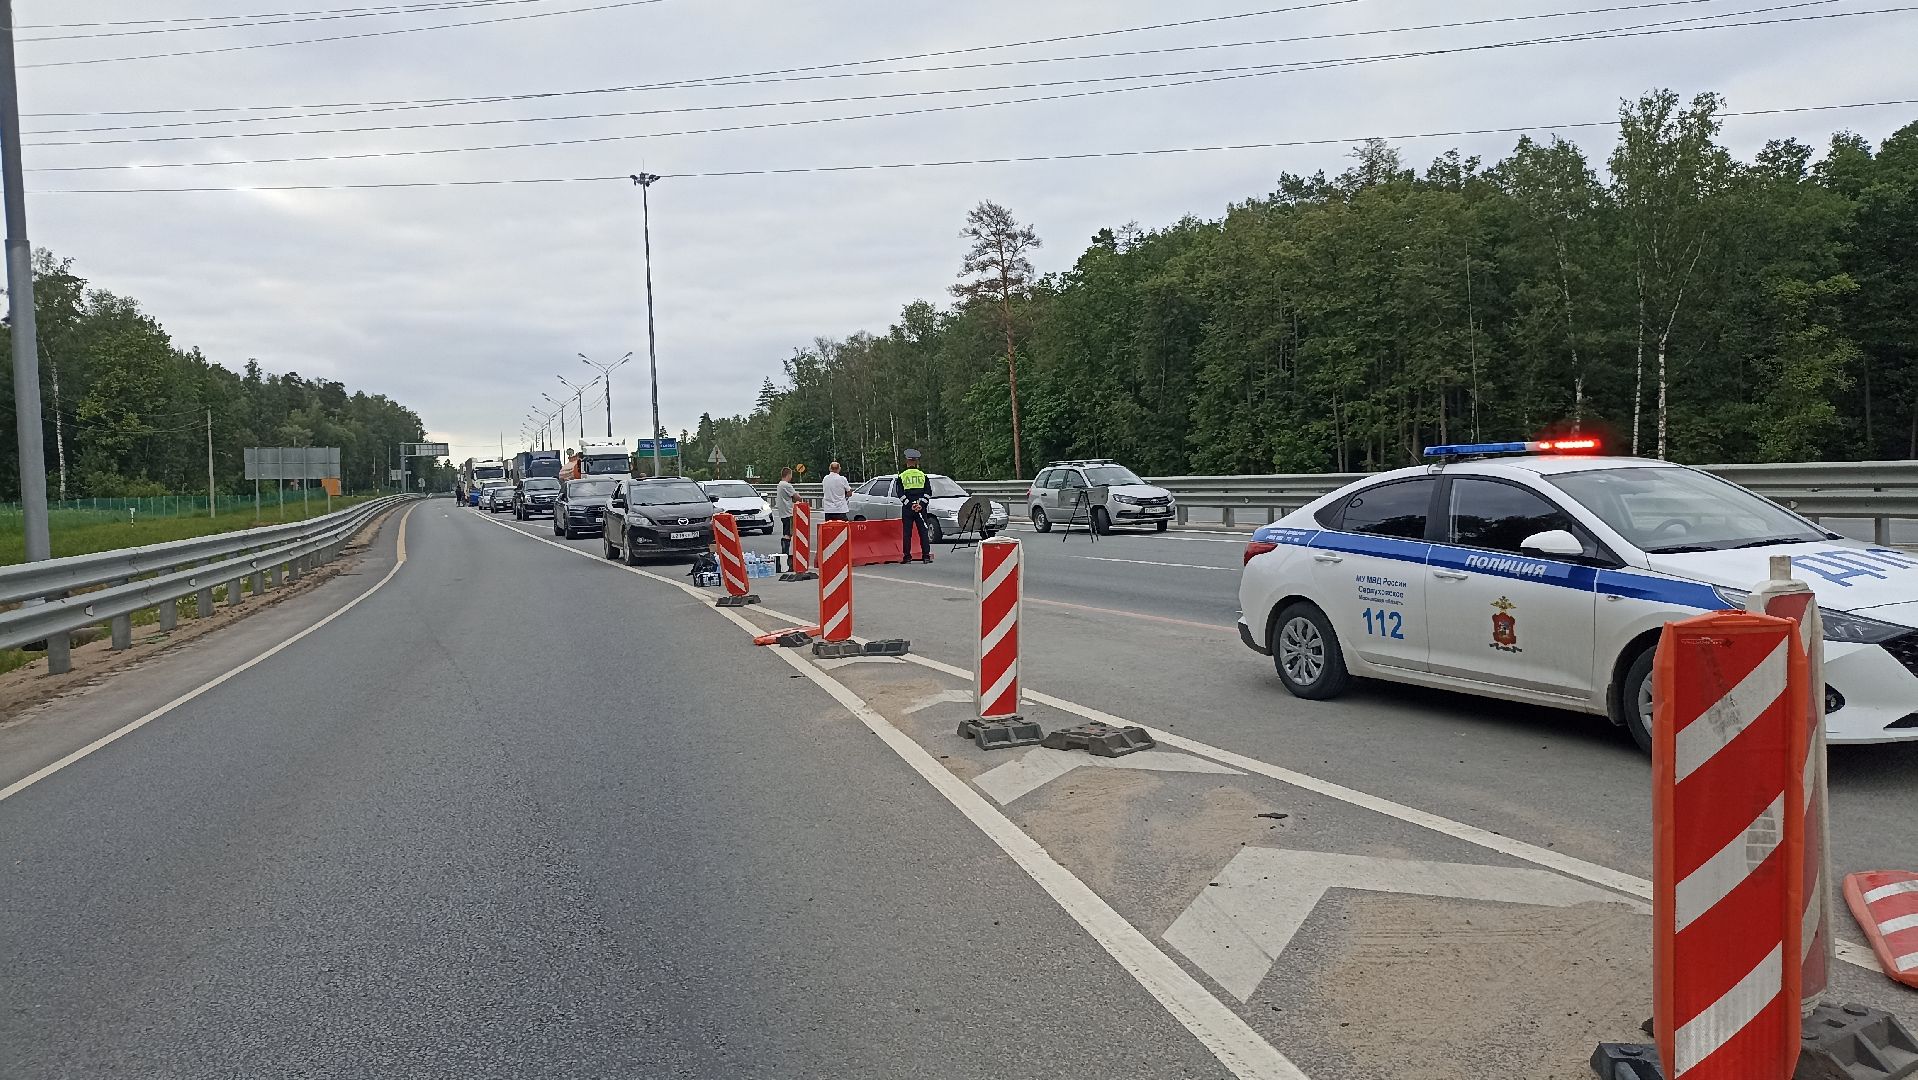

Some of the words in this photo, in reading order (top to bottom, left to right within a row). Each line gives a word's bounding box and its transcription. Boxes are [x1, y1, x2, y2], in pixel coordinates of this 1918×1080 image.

[904, 475, 925, 485] ДПС
[1465, 554, 1548, 578] ПОЛИЦИЯ
[1366, 575, 1382, 586] МВД
[1382, 577, 1407, 588] России
[1362, 607, 1405, 640] 112
